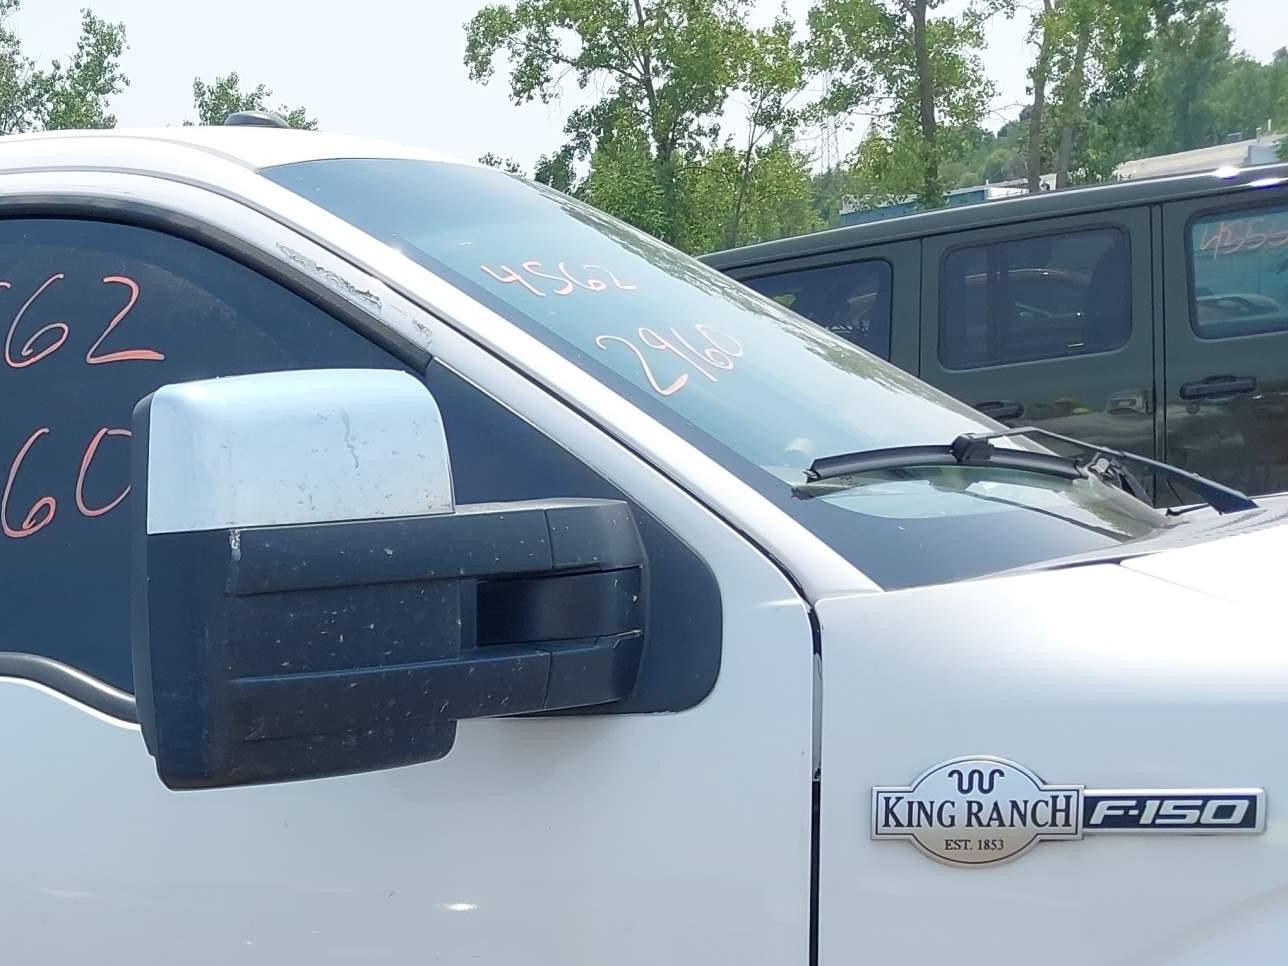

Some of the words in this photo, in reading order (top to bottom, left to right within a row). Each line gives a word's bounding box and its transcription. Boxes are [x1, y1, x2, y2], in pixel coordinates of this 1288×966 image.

[479, 260, 637, 297] 4562
[595, 323, 744, 396] 2960
[882, 796, 956, 828] KING
[965, 795, 1073, 828] RANCH
[1088, 799, 1250, 825] F-150
[944, 839, 973, 851] EST.
[977, 839, 1005, 851] 1853
